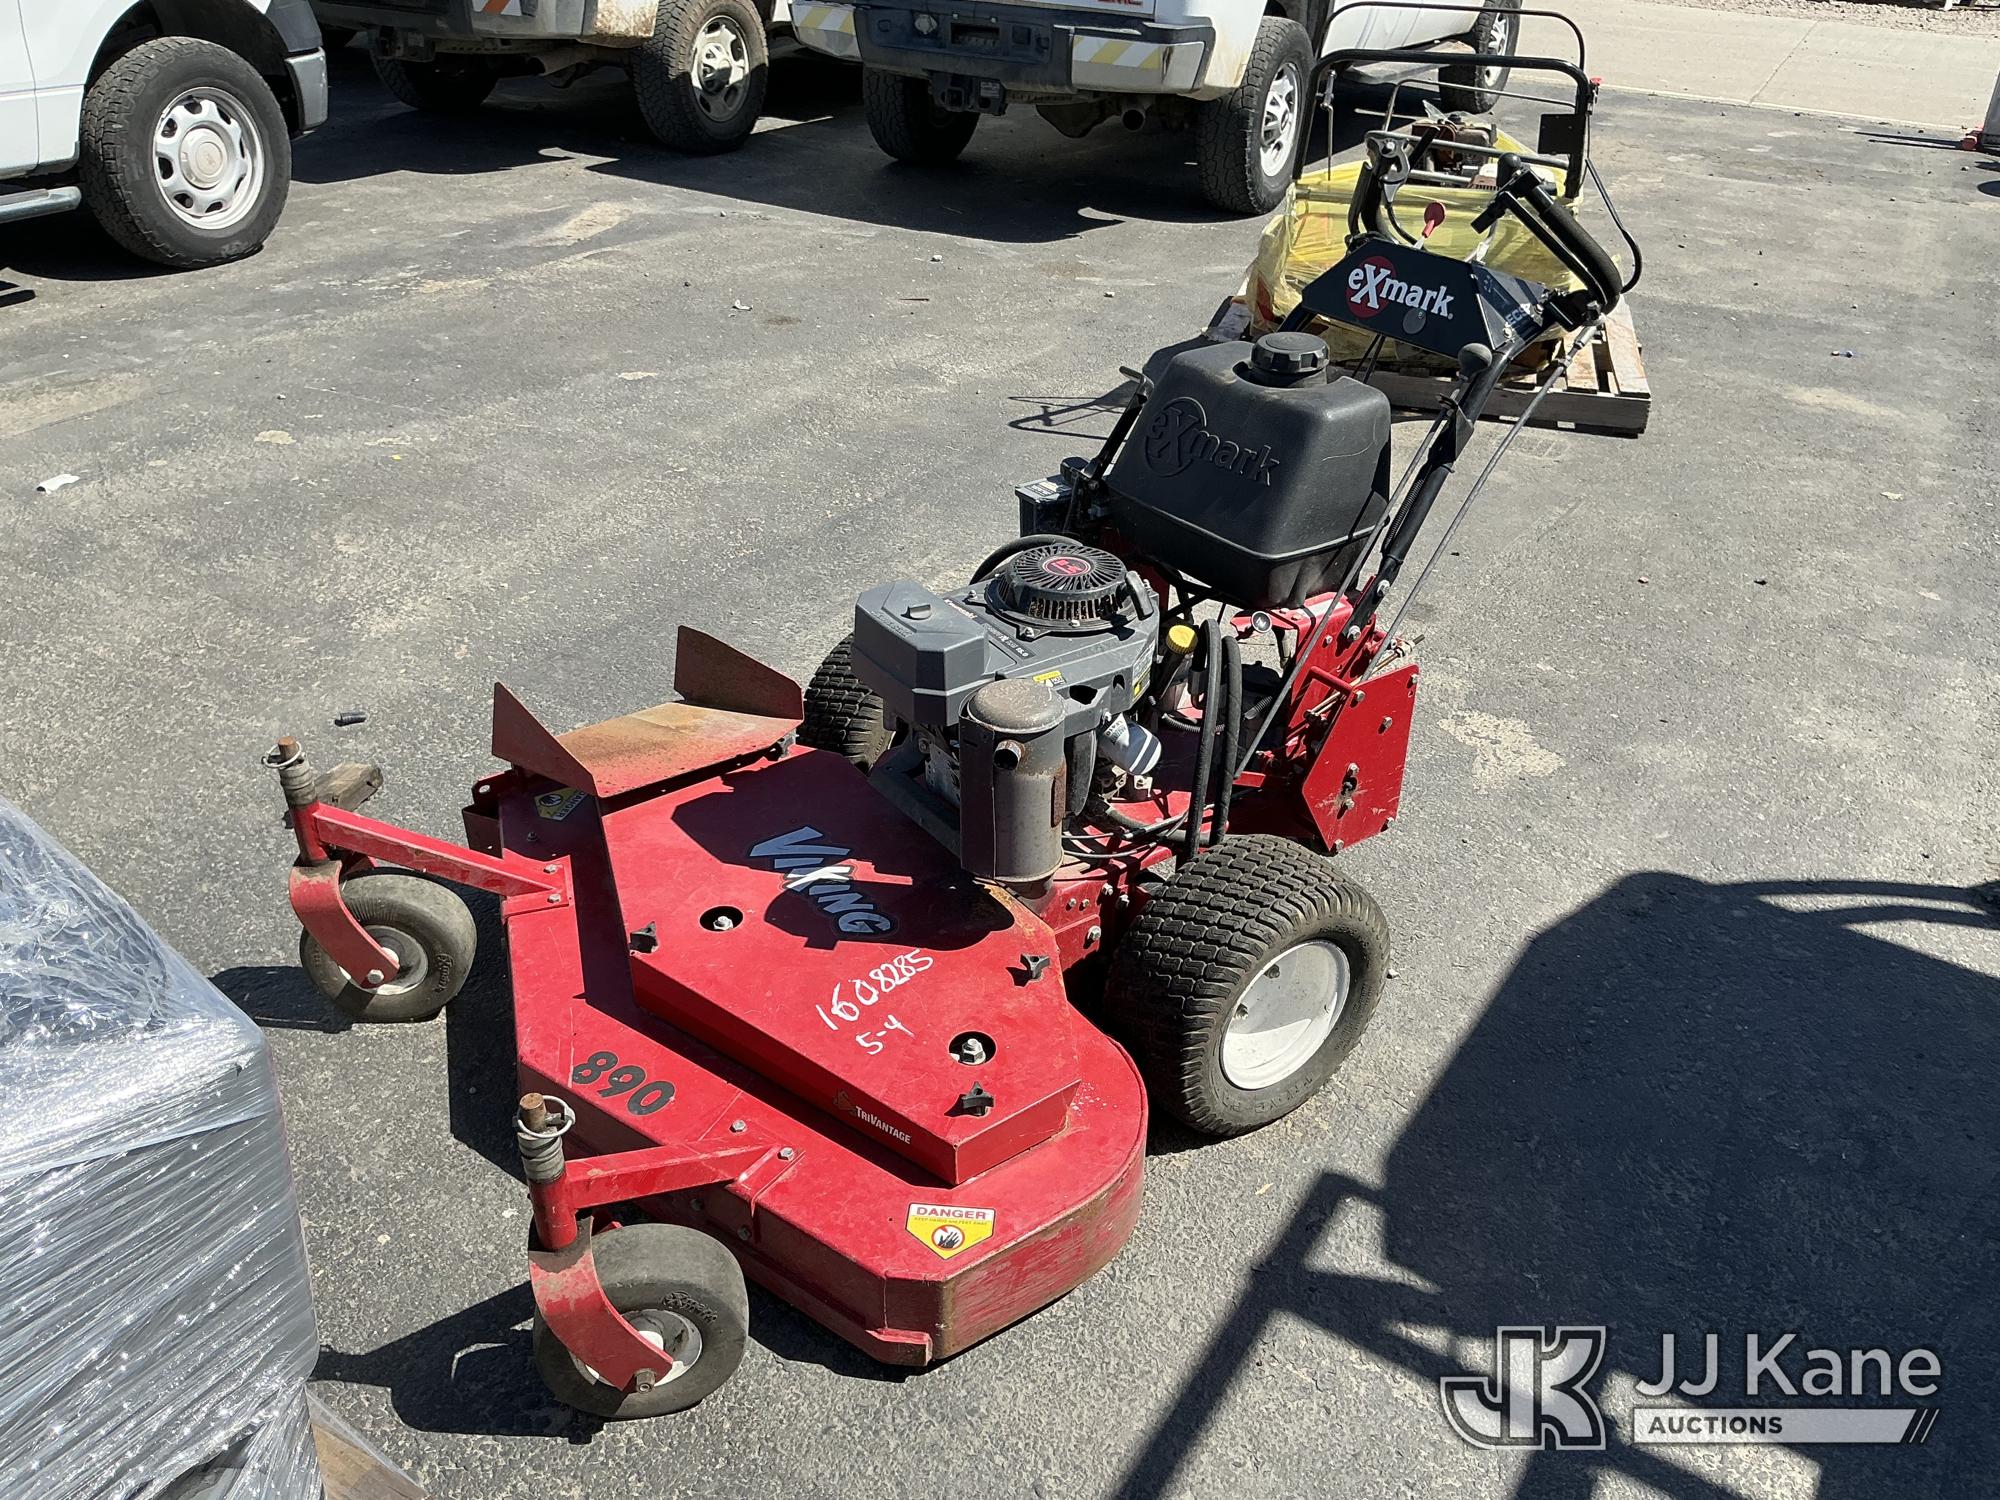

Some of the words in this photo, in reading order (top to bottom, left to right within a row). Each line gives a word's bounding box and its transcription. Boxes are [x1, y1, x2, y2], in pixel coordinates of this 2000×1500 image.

[815, 948, 934, 1031] 1608285
[572, 1050, 677, 1116] 890
[916, 1206, 987, 1220] DANGER
